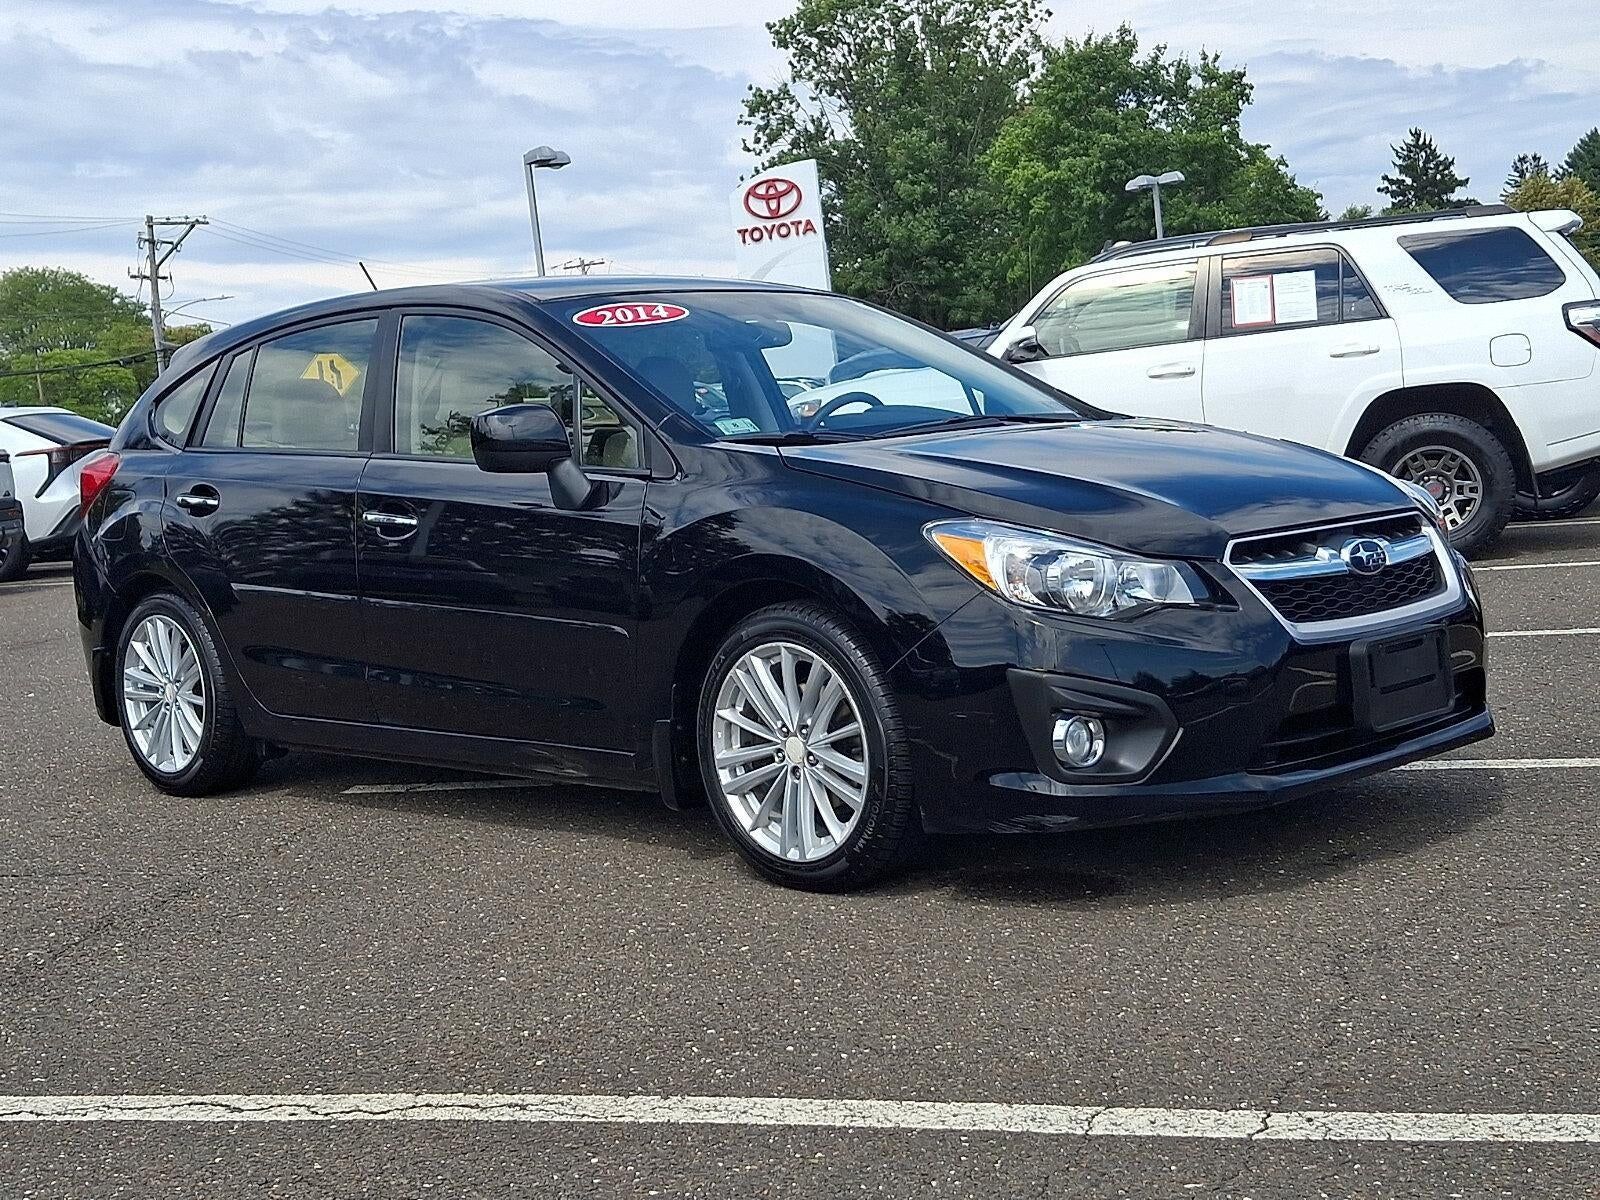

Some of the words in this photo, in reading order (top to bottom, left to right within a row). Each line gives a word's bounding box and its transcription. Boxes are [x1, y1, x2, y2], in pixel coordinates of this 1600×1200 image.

[737, 219, 817, 244] TOYOTA
[597, 305, 669, 325] 2014
[853, 800, 880, 853] YOKOHAMA
